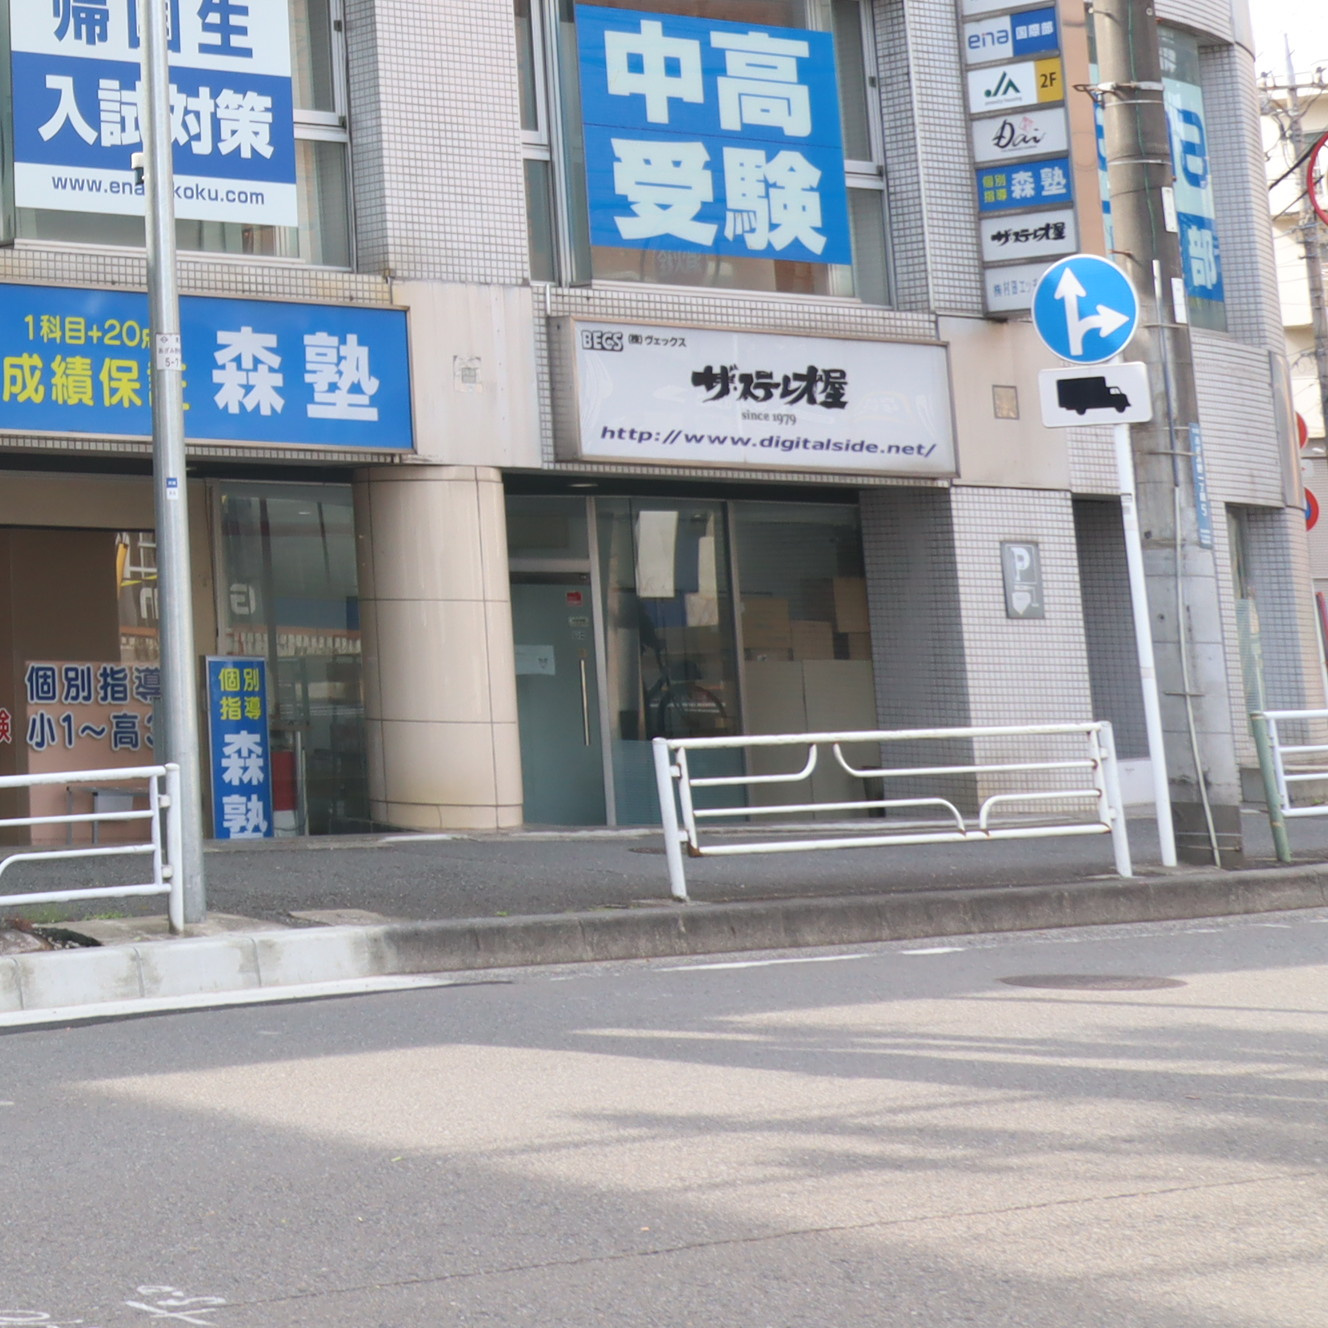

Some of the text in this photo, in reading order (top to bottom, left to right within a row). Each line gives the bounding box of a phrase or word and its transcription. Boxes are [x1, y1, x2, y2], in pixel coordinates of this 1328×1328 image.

[968, 29, 1009, 49] ena
[604, 19, 812, 137] 中高
[1040, 72, 1056, 88] 2F
[38, 74, 274, 159] 入試対策
[611, 138, 827, 256] 受験
[1011, 166, 1067, 199] 森塾
[581, 330, 624, 352] BECS
[2, 353, 190, 412] 成績保
[213, 326, 379, 422] 森塾
[741, 410, 797, 426] since 1979
[600, 426, 938, 458] http://www.digitalside.net/
[25, 665, 161, 704] 個別指導
[218, 667, 260, 692] 個別
[219, 696, 262, 721] 指導
[221, 730, 269, 839] 森塾
